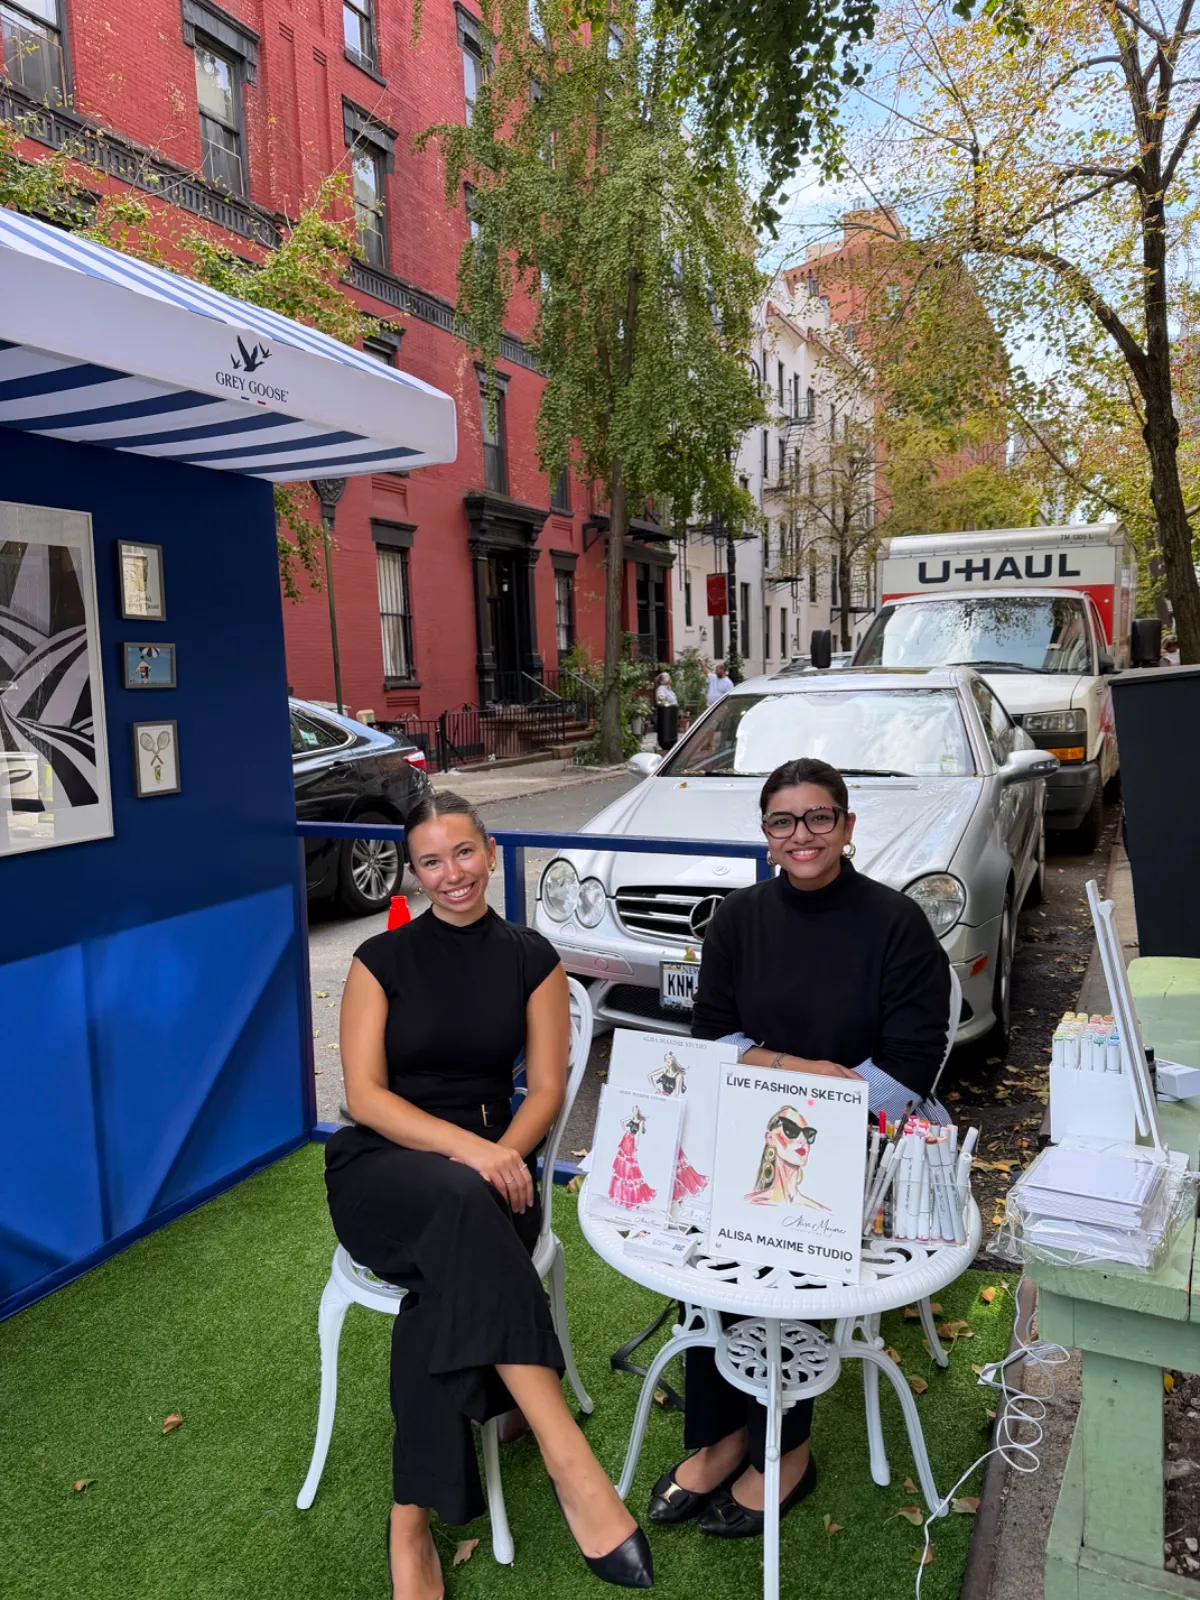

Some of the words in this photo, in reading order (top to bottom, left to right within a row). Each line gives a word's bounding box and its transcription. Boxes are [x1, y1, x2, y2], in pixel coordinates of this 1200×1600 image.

[215, 371, 246, 391] GREY
[249, 380, 287, 403] GOOSE
[918, 553, 1081, 584] U-HAUL
[726, 1075, 751, 1088] LIVE
[754, 1079, 808, 1097] FASHION
[811, 1088, 862, 1104] SKETCH
[718, 1228, 753, 1243] ALISA
[756, 1235, 804, 1252] MAXIME
[807, 1244, 853, 1262] STUDIO
